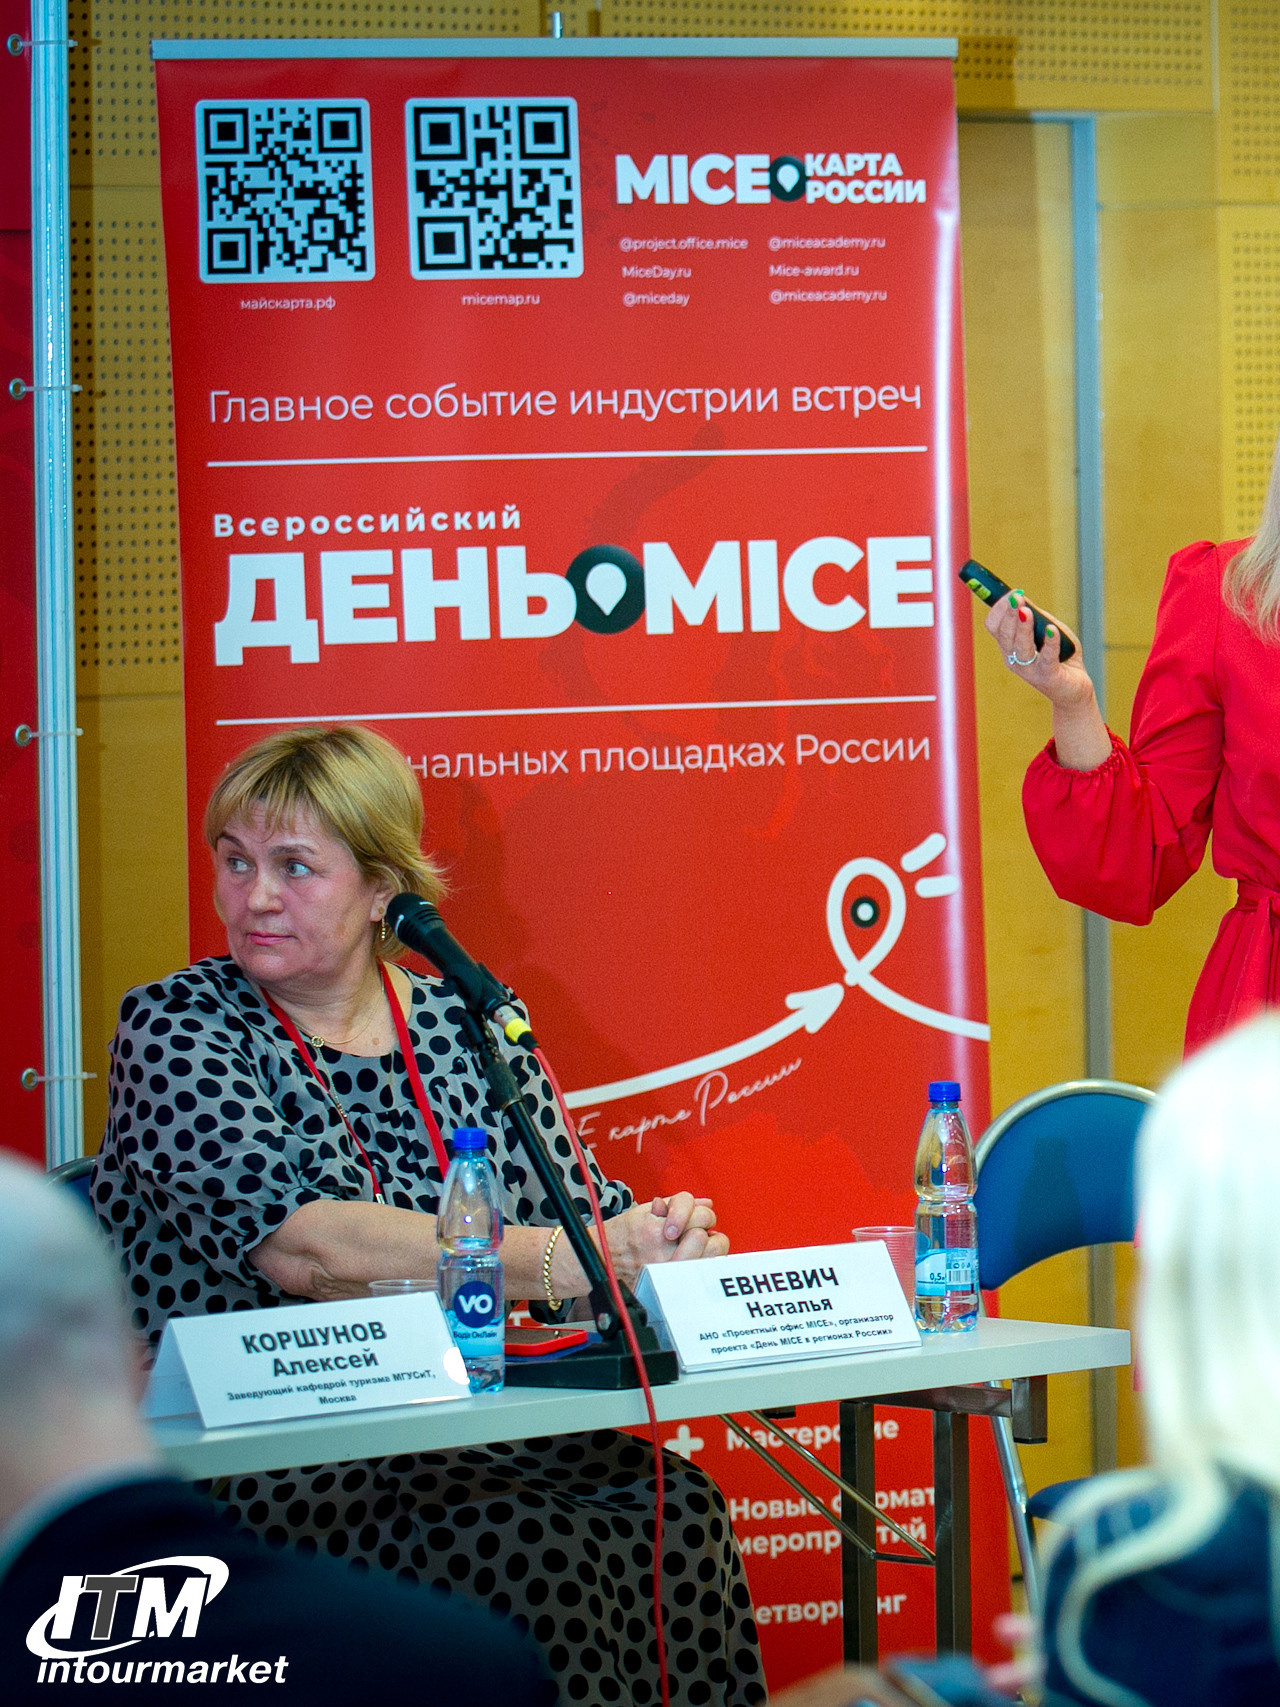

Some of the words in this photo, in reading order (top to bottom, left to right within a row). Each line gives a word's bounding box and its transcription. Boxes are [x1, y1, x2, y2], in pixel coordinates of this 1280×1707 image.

[804, 152, 903, 177] КАРТА
[615, 153, 771, 205] MICE
[804, 179, 927, 204] РОССИИ
[619, 237, 748, 252] @project.office.mice
[768, 236, 886, 251] @miceacademy.ru
[622, 265, 692, 279] MiceDay.ru
[769, 263, 859, 277] Mice-award.ru
[240, 295, 336, 312] майскарта.рф
[461, 293, 540, 308] micemap.ru
[623, 292, 690, 307] @miceday
[770, 289, 887, 304] @miceacademy.ru
[209, 390, 374, 425] Главное
[385, 383, 557, 422] событие
[568, 386, 779, 421] индустрии
[791, 383, 922, 419] встреч
[213, 505, 522, 541] Всероссийский
[214, 544, 578, 666] ДЕНЬ
[644, 535, 936, 635] MICE
[579, 743, 786, 776] площадках
[797, 733, 932, 766] России
[719, 1266, 840, 1298] ЕВНЕВИЧ
[746, 1298, 833, 1319] Наталья
[241, 1321, 387, 1354] КОРШУНОВ
[453, 1331, 471, 1339] Вода
[699, 1331, 719, 1342] АНО
[722, 1324, 778, 1340] «Проектный
[780, 1321, 804, 1335] офис
[806, 1318, 837, 1329] MICE»,
[838, 1313, 894, 1327] организатор
[711, 1343, 748, 1355] проекта
[749, 1340, 778, 1351] «День
[780, 1336, 803, 1346] MICE
[812, 1332, 853, 1345] регионах
[855, 1328, 893, 1338] России»
[272, 1347, 379, 1377] Алексей
[227, 1384, 294, 1402] Заведующий
[296, 1378, 346, 1395] кафедрой
[349, 1374, 390, 1388] туризма
[392, 1369, 436, 1383] МГУСиТ,
[319, 1393, 356, 1406] Москва
